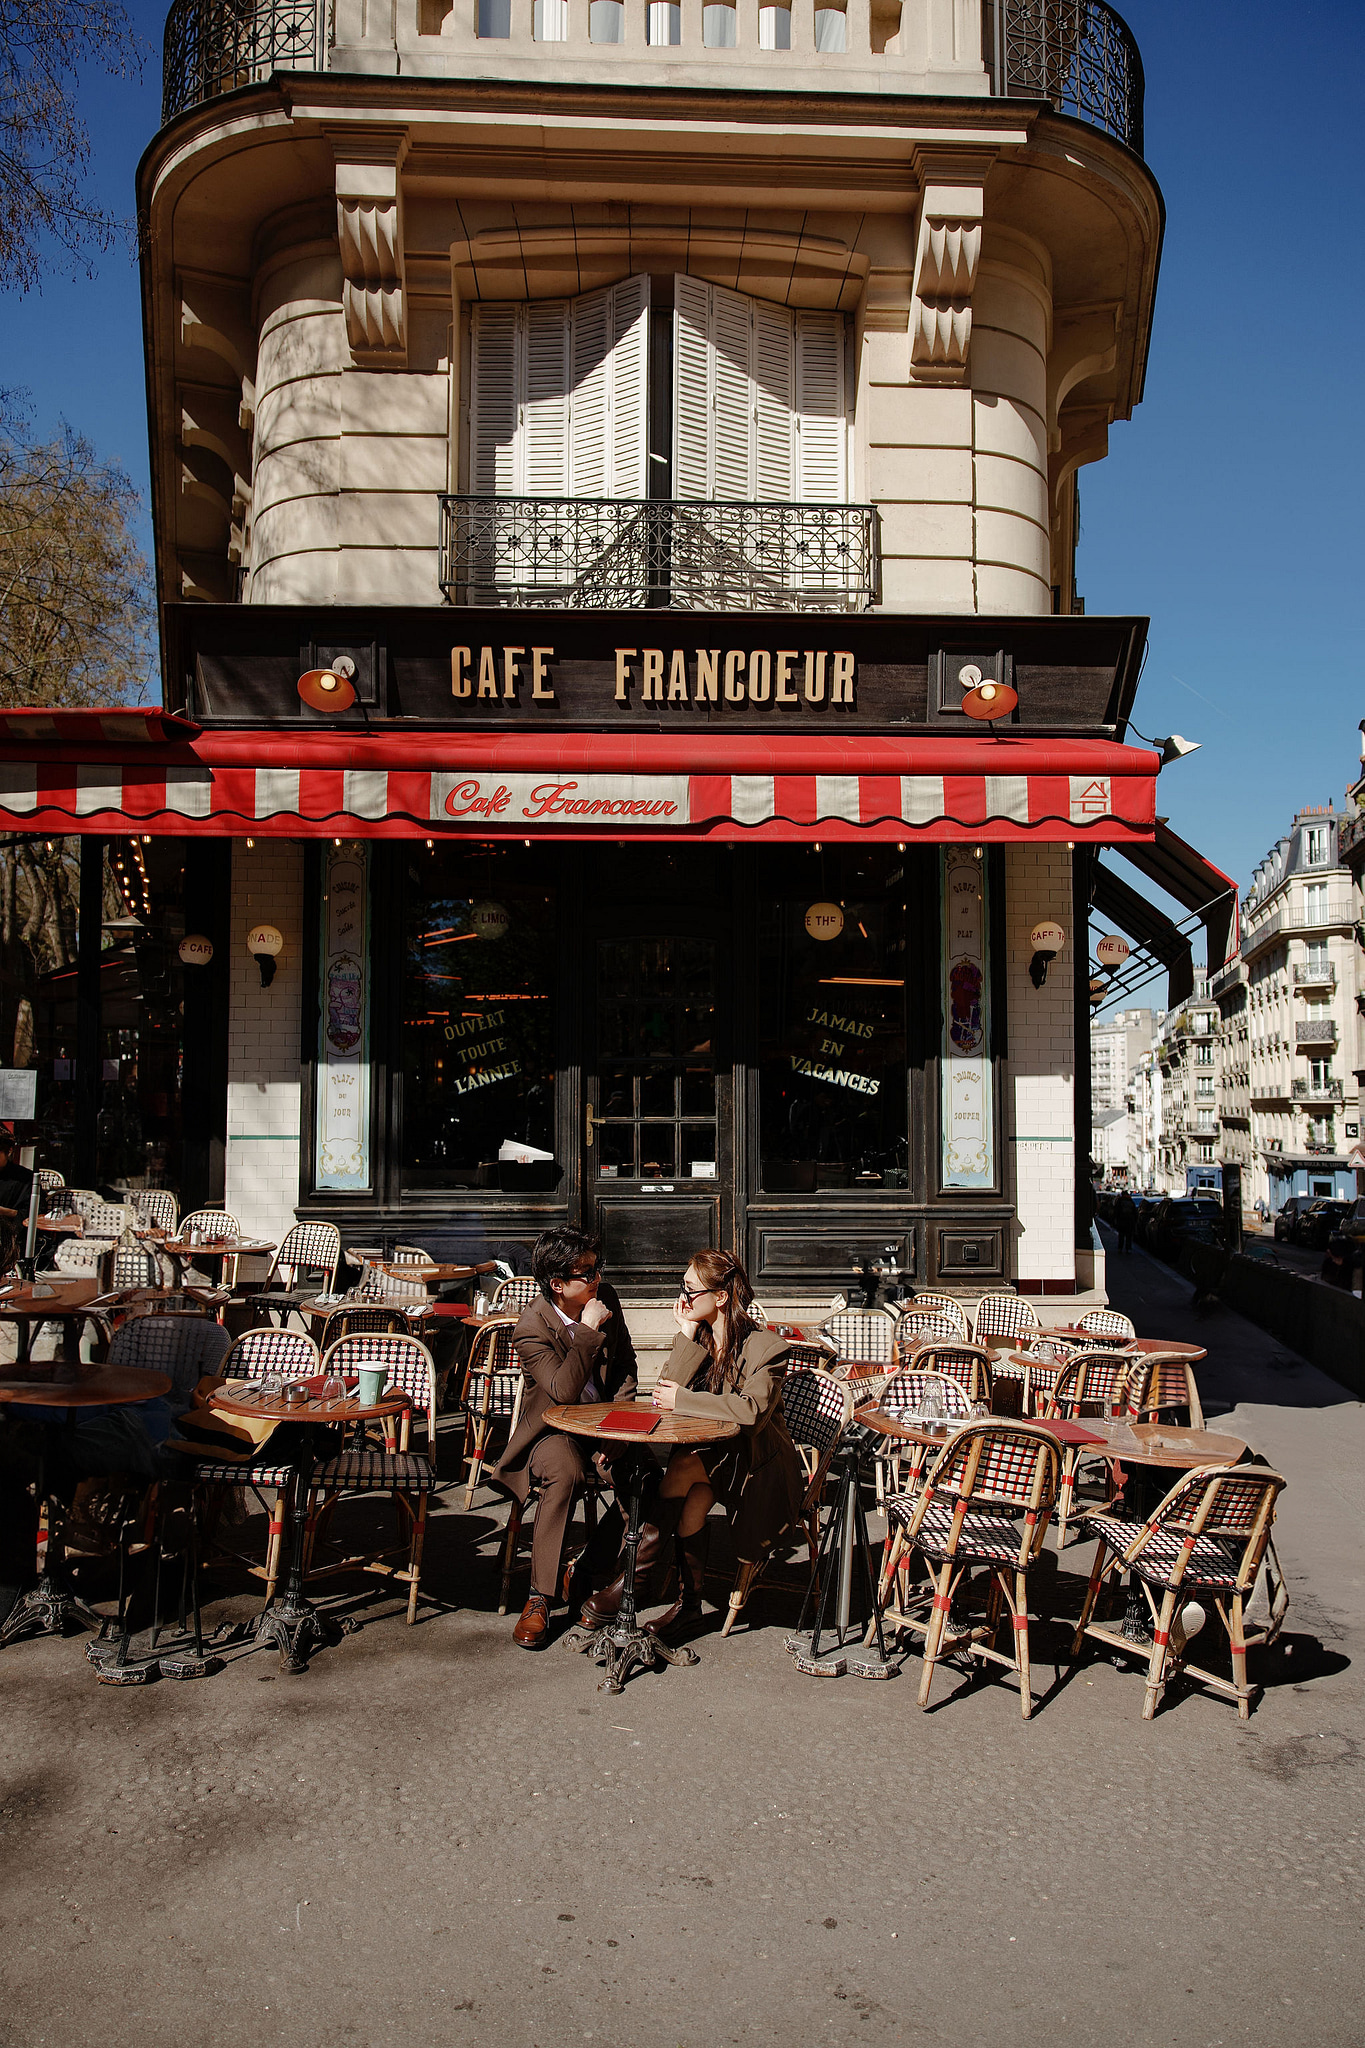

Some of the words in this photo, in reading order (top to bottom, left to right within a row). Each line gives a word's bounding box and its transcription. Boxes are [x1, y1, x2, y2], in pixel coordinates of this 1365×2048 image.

[451, 646, 555, 699] CAFE
[614, 647, 855, 703] FRANCOEUR
[445, 780, 513, 818] Café
[953, 882, 976, 894] OEUFS
[957, 930, 973, 938] PLAT
[190, 943, 212, 955] CAFE
[444, 1009, 506, 1040] OUVERT
[807, 1008, 874, 1039] JAMAIS
[457, 1037, 507, 1063] TOUTE
[820, 1039, 845, 1057] EN
[331, 1073, 355, 1086] PLATS
[790, 1055, 881, 1095] VACANCES
[333, 1108, 351, 1118] JOUR
[954, 1112, 980, 1121] SOUPER
